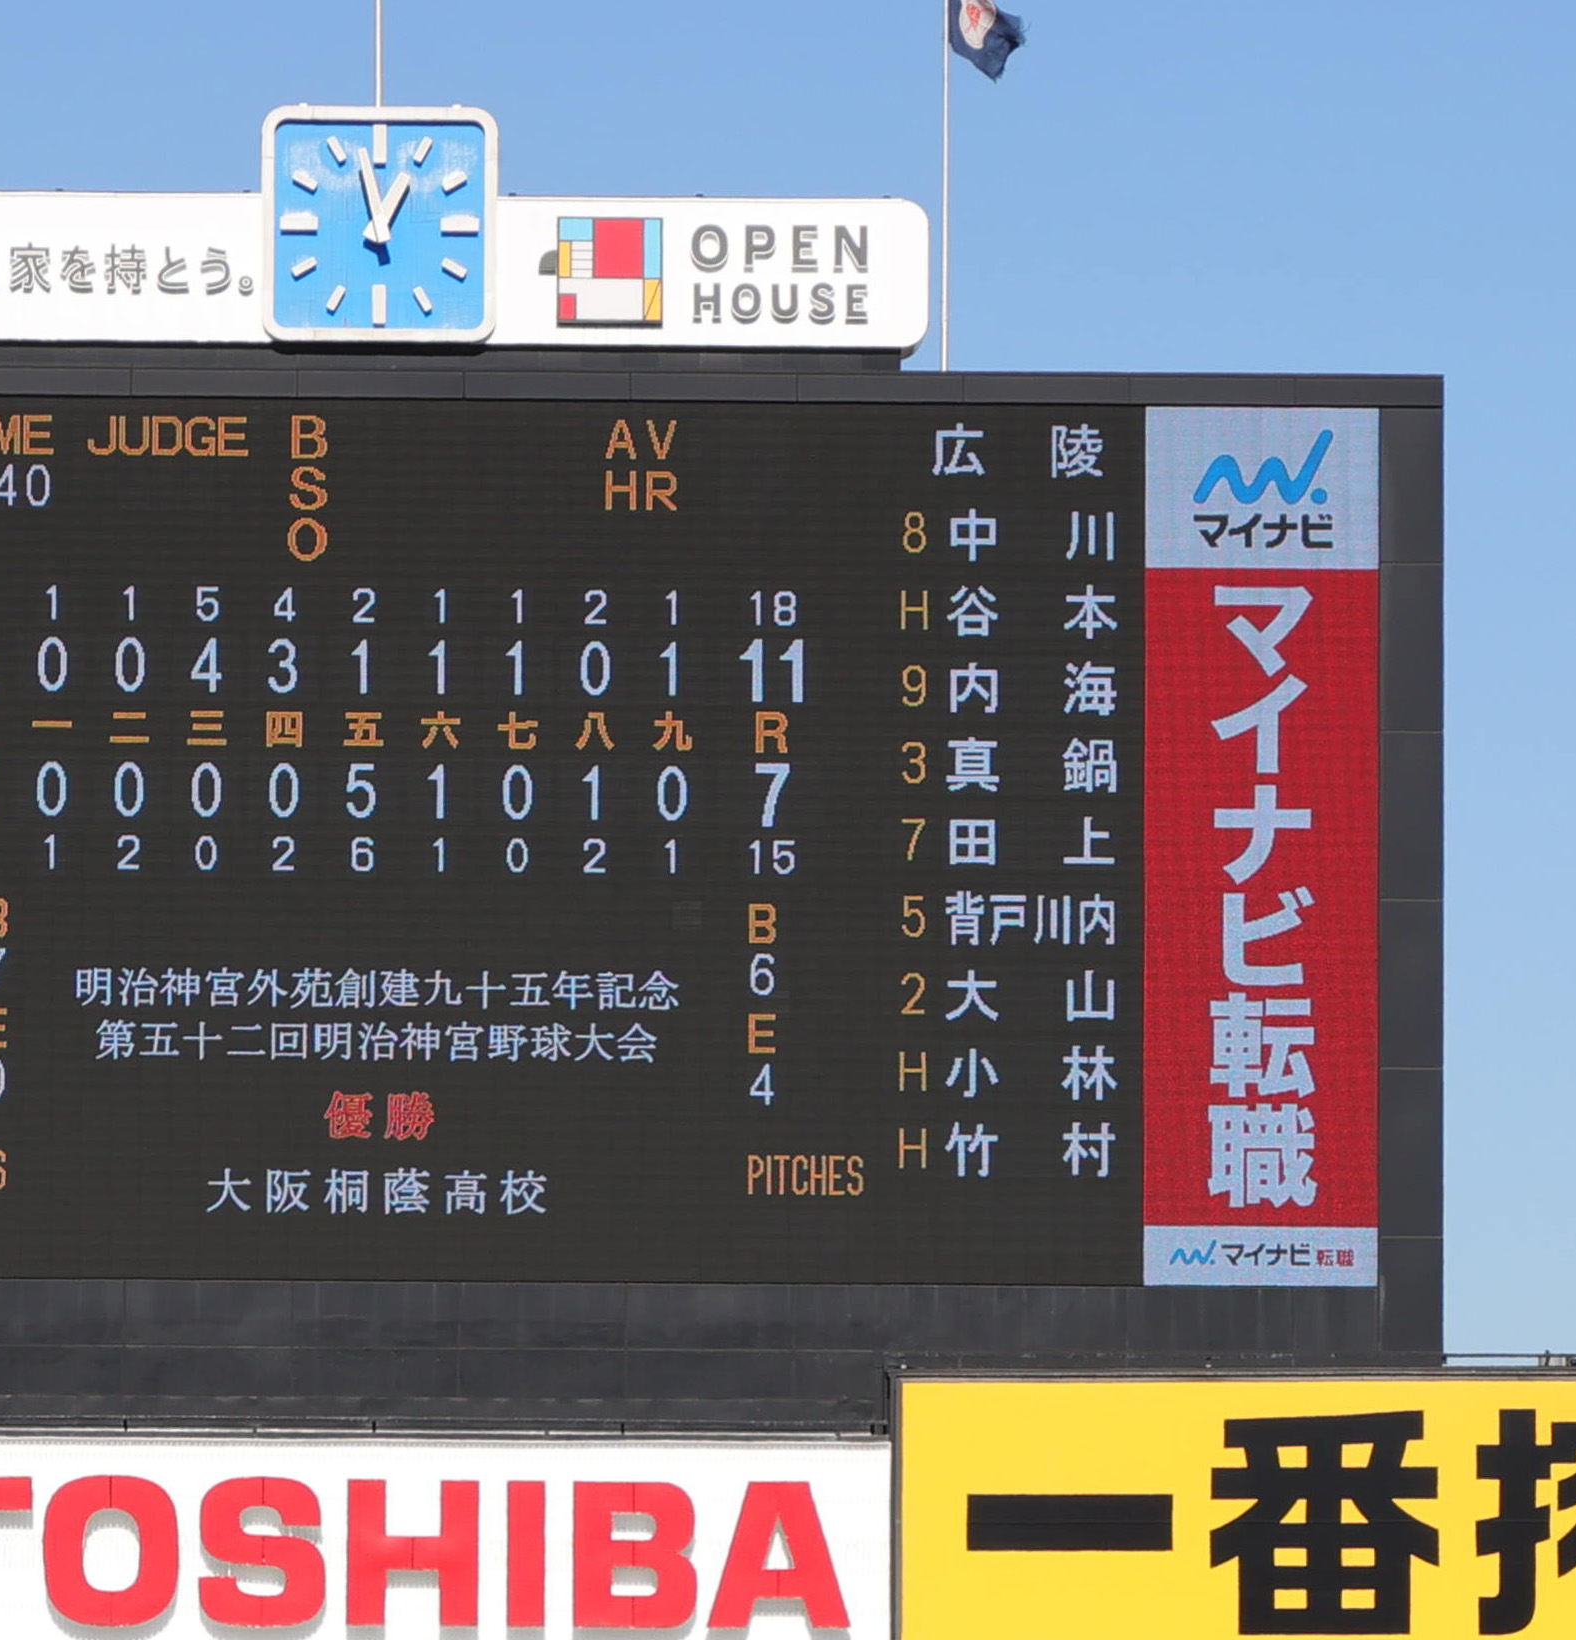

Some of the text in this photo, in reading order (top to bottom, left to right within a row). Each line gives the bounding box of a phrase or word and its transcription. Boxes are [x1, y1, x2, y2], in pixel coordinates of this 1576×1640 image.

[690, 223, 870, 275] OPEN
[694, 281, 870, 326] HOUSE
[88, 416, 248, 456] JUDGE
[291, 415, 327, 458] B
[606, 420, 676, 459] AV
[932, 423, 1103, 478] 広陵
[290, 466, 327, 510] S
[605, 471, 677, 510] HR
[903, 512, 926, 552] 8
[1193, 514, 1333, 550] マイナビ
[46, 585, 57, 620] 1
[123, 586, 134, 620] 1
[197, 586, 219, 621] 5
[274, 587, 296, 622] 4
[353, 588, 375, 623] 2
[435, 589, 445, 623] 1
[512, 589, 522, 623] 1
[585, 590, 607, 625] 2
[666, 590, 677, 625] 1
[751, 591, 796, 626] 18
[901, 591, 928, 629] H
[38, 637, 67, 691] 0
[116, 637, 145, 692] 0
[191, 638, 222, 692] 4
[268, 639, 297, 693] 3
[352, 639, 368, 694] 1
[429, 640, 445, 694] 1
[506, 641, 522, 695] 1
[580, 641, 610, 696] 0
[660, 642, 677, 696] 1
[740, 639, 803, 703] 11
[902, 665, 926, 706] 9
[110, 712, 149, 743] 二
[187, 711, 227, 745] 三
[266, 711, 302, 747] 四
[343, 712, 383, 746] 五
[421, 711, 460, 748] 六
[498, 712, 538, 749] 七
[576, 712, 614, 749] 八
[653, 711, 692, 750] 九
[756, 711, 788, 753] R
[902, 742, 925, 783] 3
[37, 761, 67, 816] 0
[114, 762, 144, 817] 0
[192, 762, 221, 817] 0
[269, 763, 299, 818] 0
[346, 764, 376, 818] 5
[428, 764, 444, 819] 1
[503, 765, 533, 820] 0
[582, 765, 599, 820] 1
[657, 766, 688, 821] 0
[755, 763, 790, 827] 7
[902, 818, 925, 860] 7
[1208, 584, 1317, 1209] マイナビ転職
[749, 904, 776, 943] B
[902, 891, 1115, 945] 5 背戸川内
[76, 967, 679, 1010] 明治神宮外苑創建九十五年記念
[750, 953, 775, 996] 6
[901, 973, 925, 1014] 2
[96, 1020, 657, 1063] 第五十二回明治神宮野球大会
[748, 1014, 776, 1053] E
[750, 1064, 774, 1105] 4
[900, 1052, 926, 1091] H
[324, 1091, 435, 1141] 優勝
[899, 1128, 926, 1168] H
[207, 1168, 547, 1214] 大阪桐蔭高校
[748, 1155, 863, 1195] PITCHES
[1220, 1243, 1355, 1268] マイナビ 転職
